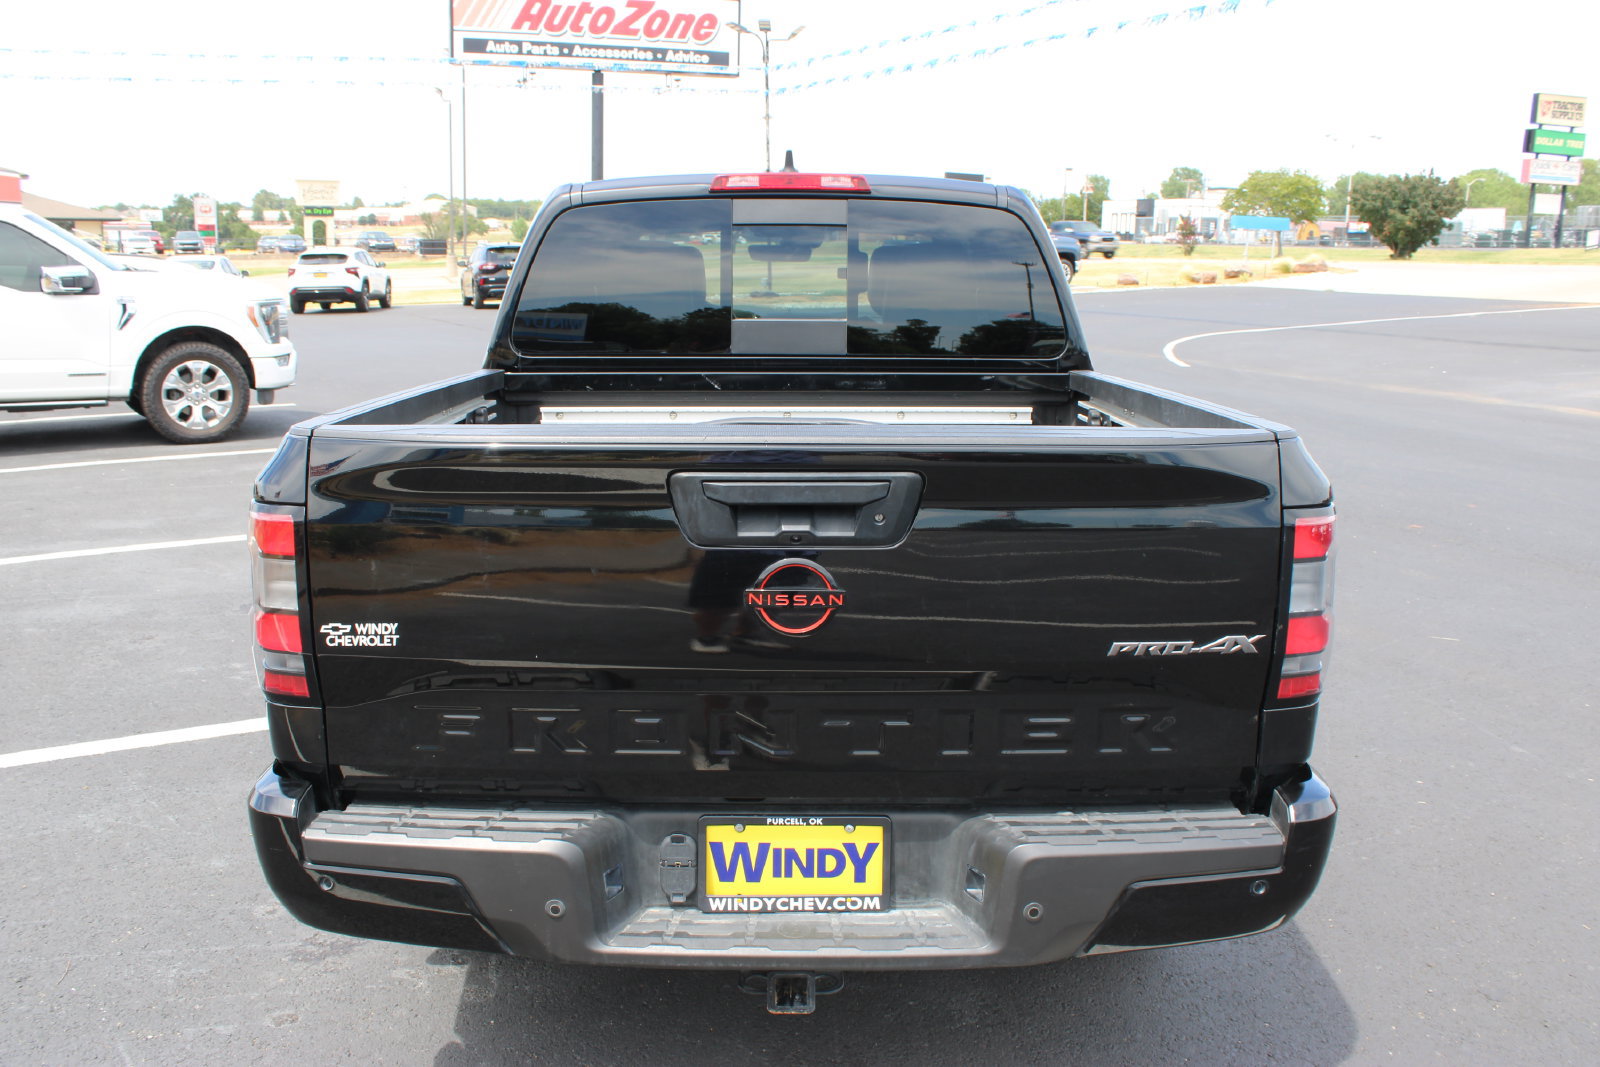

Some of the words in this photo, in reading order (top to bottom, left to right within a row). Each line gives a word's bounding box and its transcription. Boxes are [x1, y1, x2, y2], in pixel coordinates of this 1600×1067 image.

[511, 0, 719, 42] AutoZone
[486, 40, 519, 54] Auto
[522, 42, 560, 56] Parts
[572, 44, 654, 61] Accessories
[665, 51, 710, 64] Advice
[747, 593, 844, 606] NISSAN
[354, 622, 399, 635] WINDY
[325, 634, 400, 647] CHEVROLET
[1106, 634, 1267, 657] PRO-4X
[766, 817, 807, 827] PURCELL,
[808, 817, 823, 826] OK
[708, 841, 880, 883] WINDY
[708, 896, 881, 911] WINDYCHEV.COM
